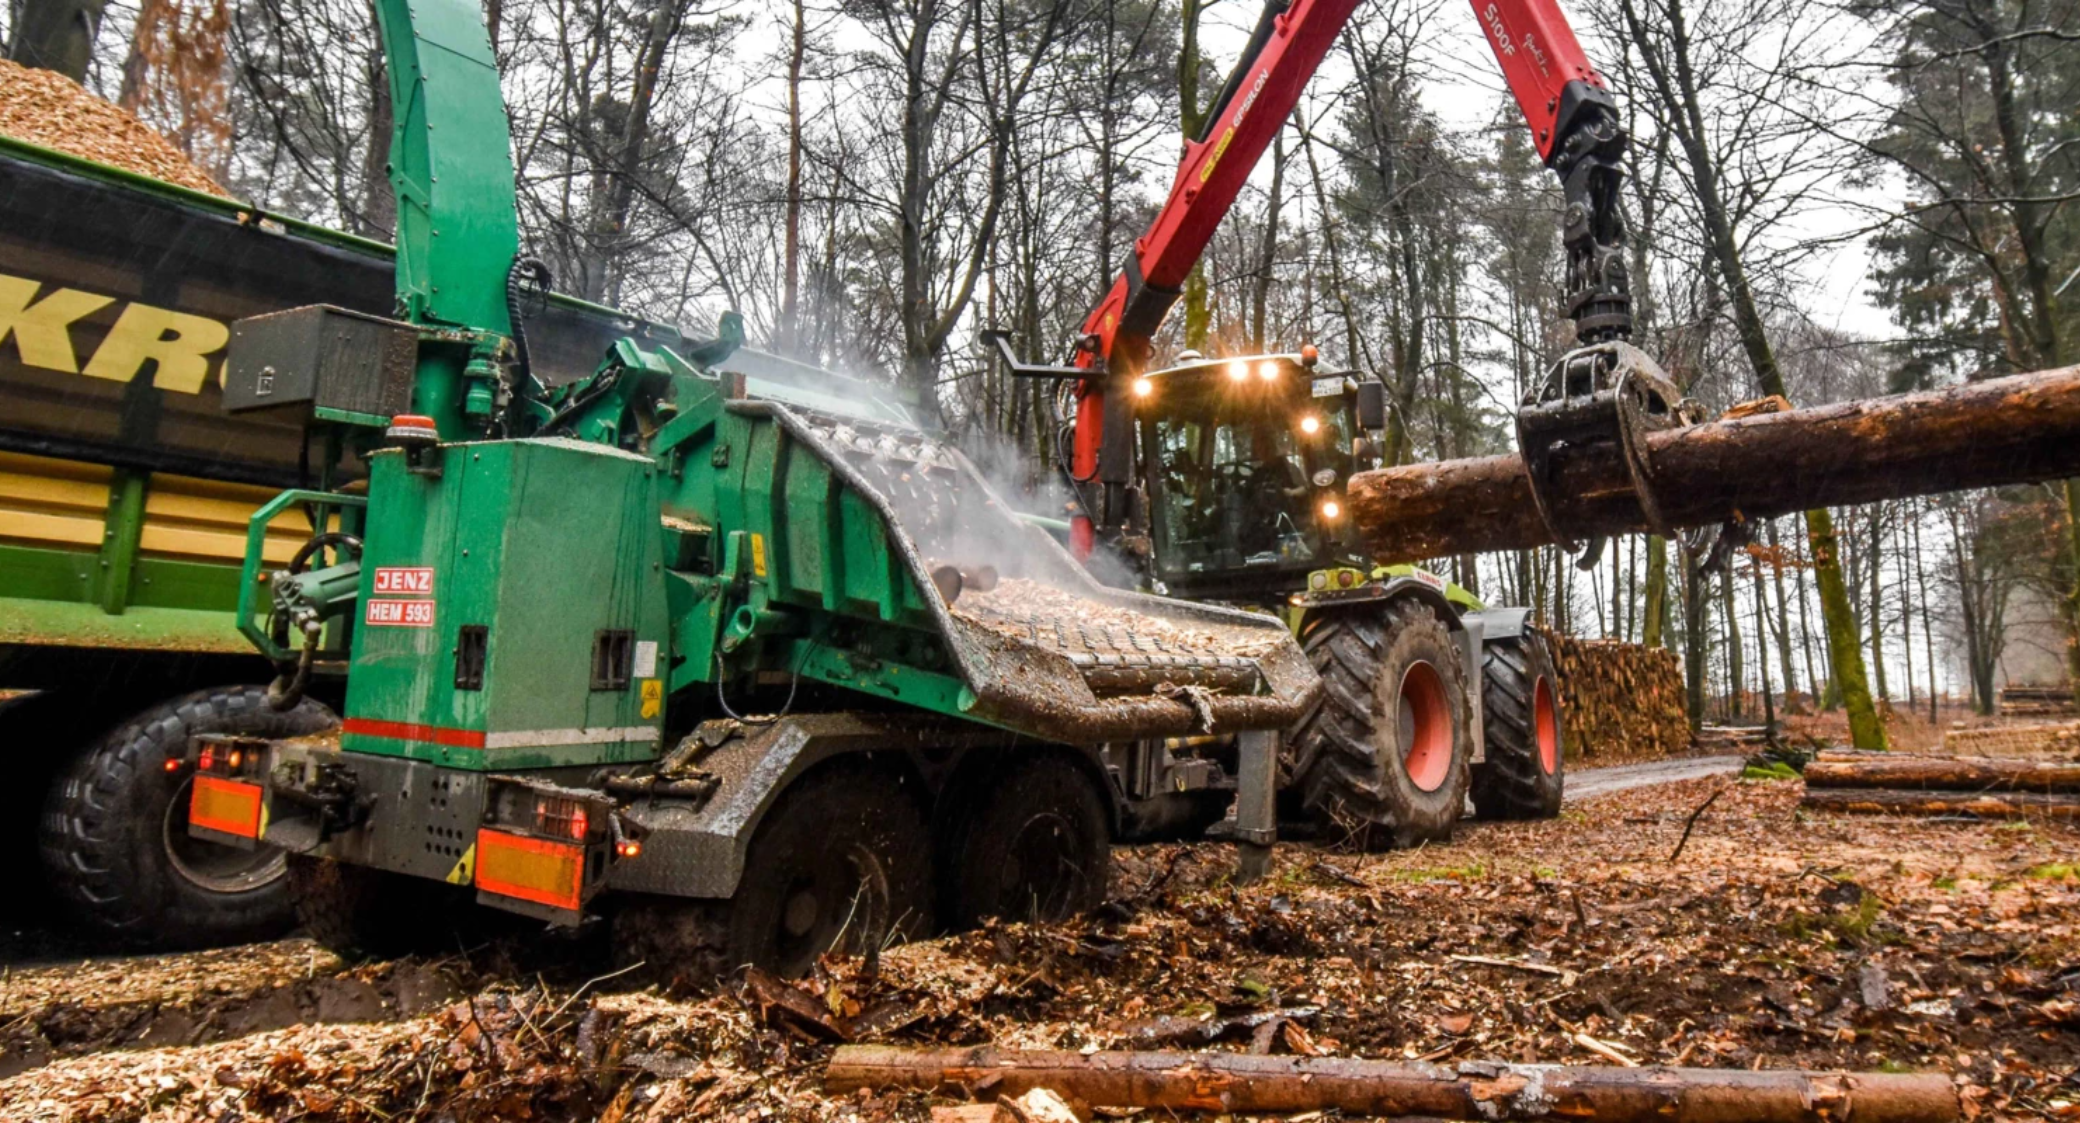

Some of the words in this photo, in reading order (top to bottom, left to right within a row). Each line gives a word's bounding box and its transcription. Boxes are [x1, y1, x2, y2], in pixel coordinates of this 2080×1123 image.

[1484, 3, 1516, 56] S100F
[1233, 68, 1269, 127] EPSILON
[0, 274, 228, 395] KR
[377, 572, 431, 590] JENZ
[369, 603, 402, 621] HEM
[405, 604, 431, 622] 593
